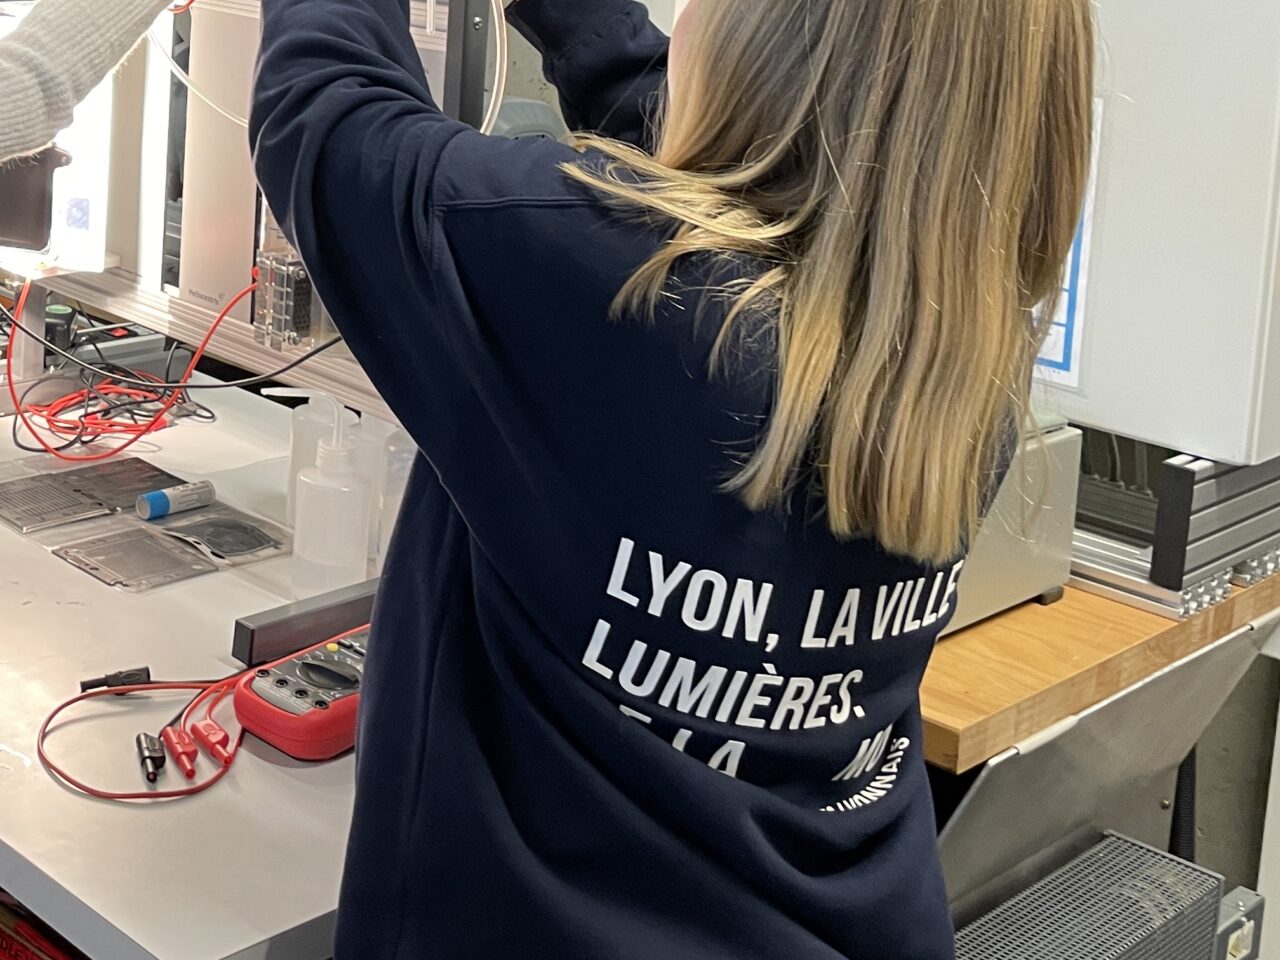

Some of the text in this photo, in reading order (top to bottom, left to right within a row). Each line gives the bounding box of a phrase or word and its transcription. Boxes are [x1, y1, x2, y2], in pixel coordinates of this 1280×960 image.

[606, 537, 965, 652] LYON, LA VILLE
[581, 618, 866, 730] LUMIÈRES.
